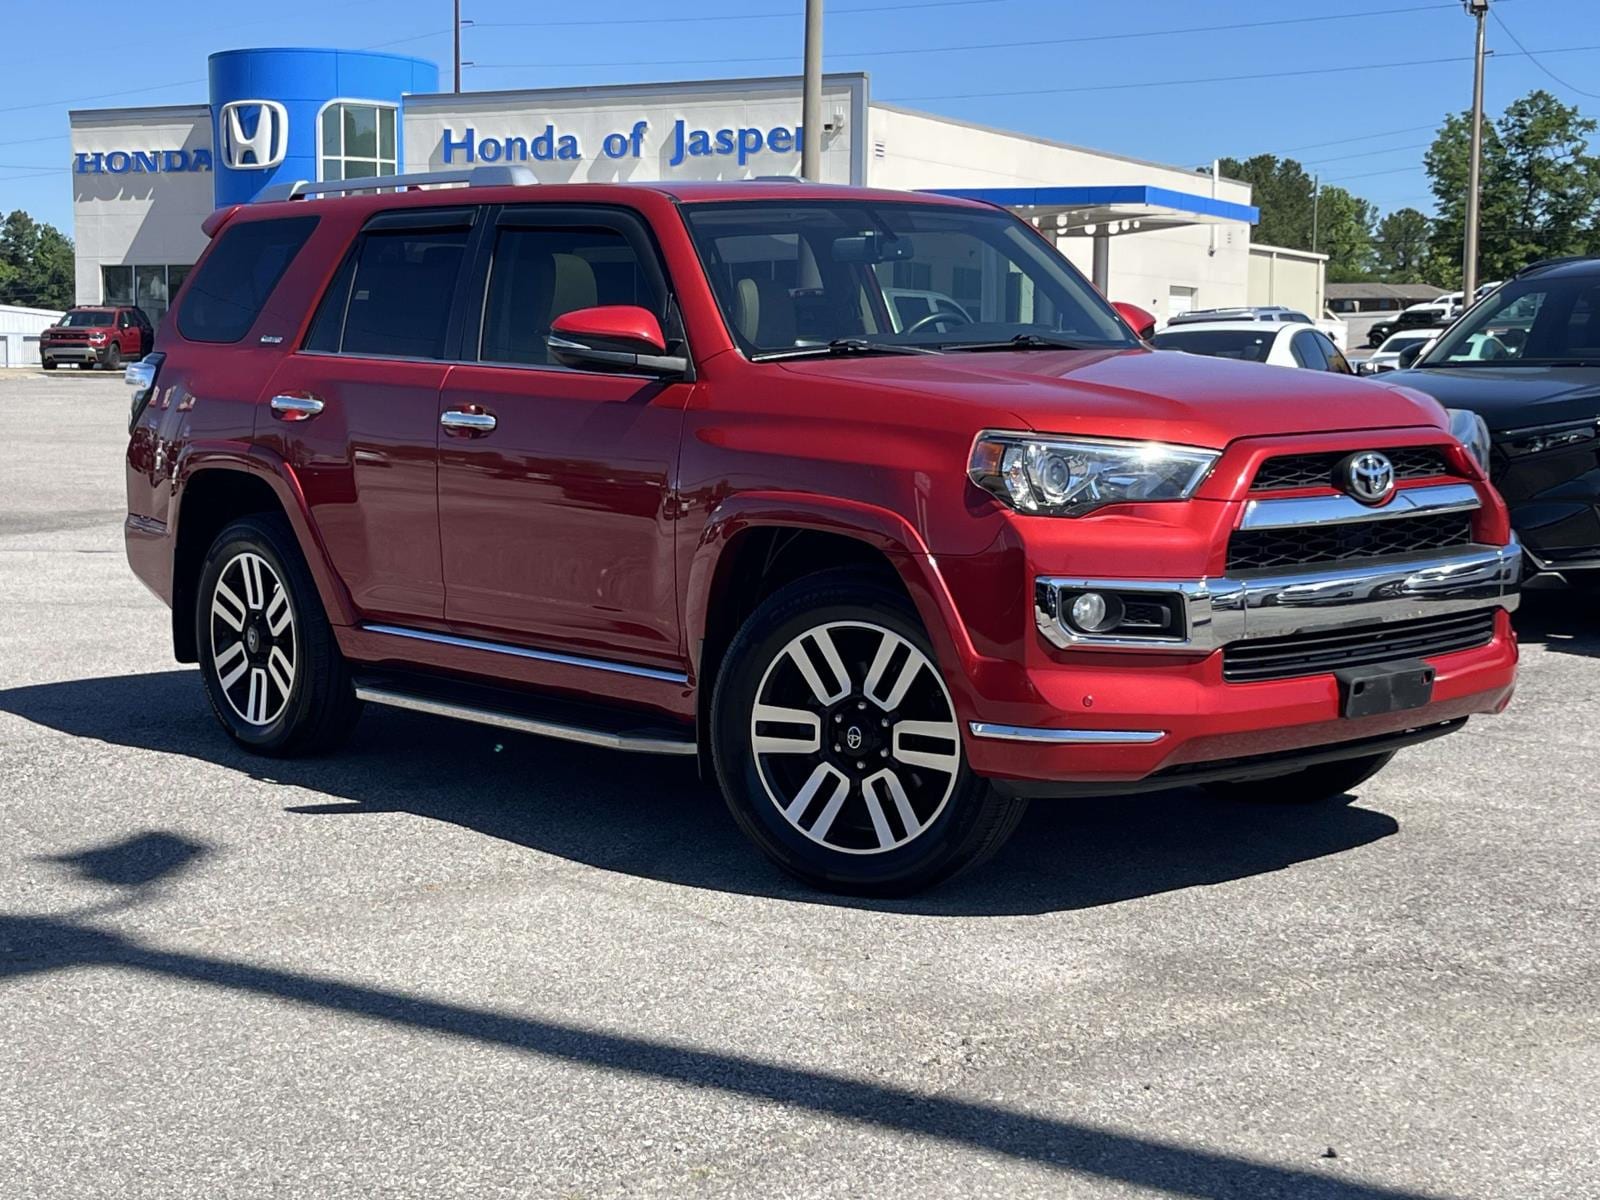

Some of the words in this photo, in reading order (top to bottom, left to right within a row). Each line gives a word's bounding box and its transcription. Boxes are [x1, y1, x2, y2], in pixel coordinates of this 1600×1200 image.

[443, 125, 580, 163] Honda
[603, 121, 648, 158] of
[75, 149, 213, 174] HONDA
